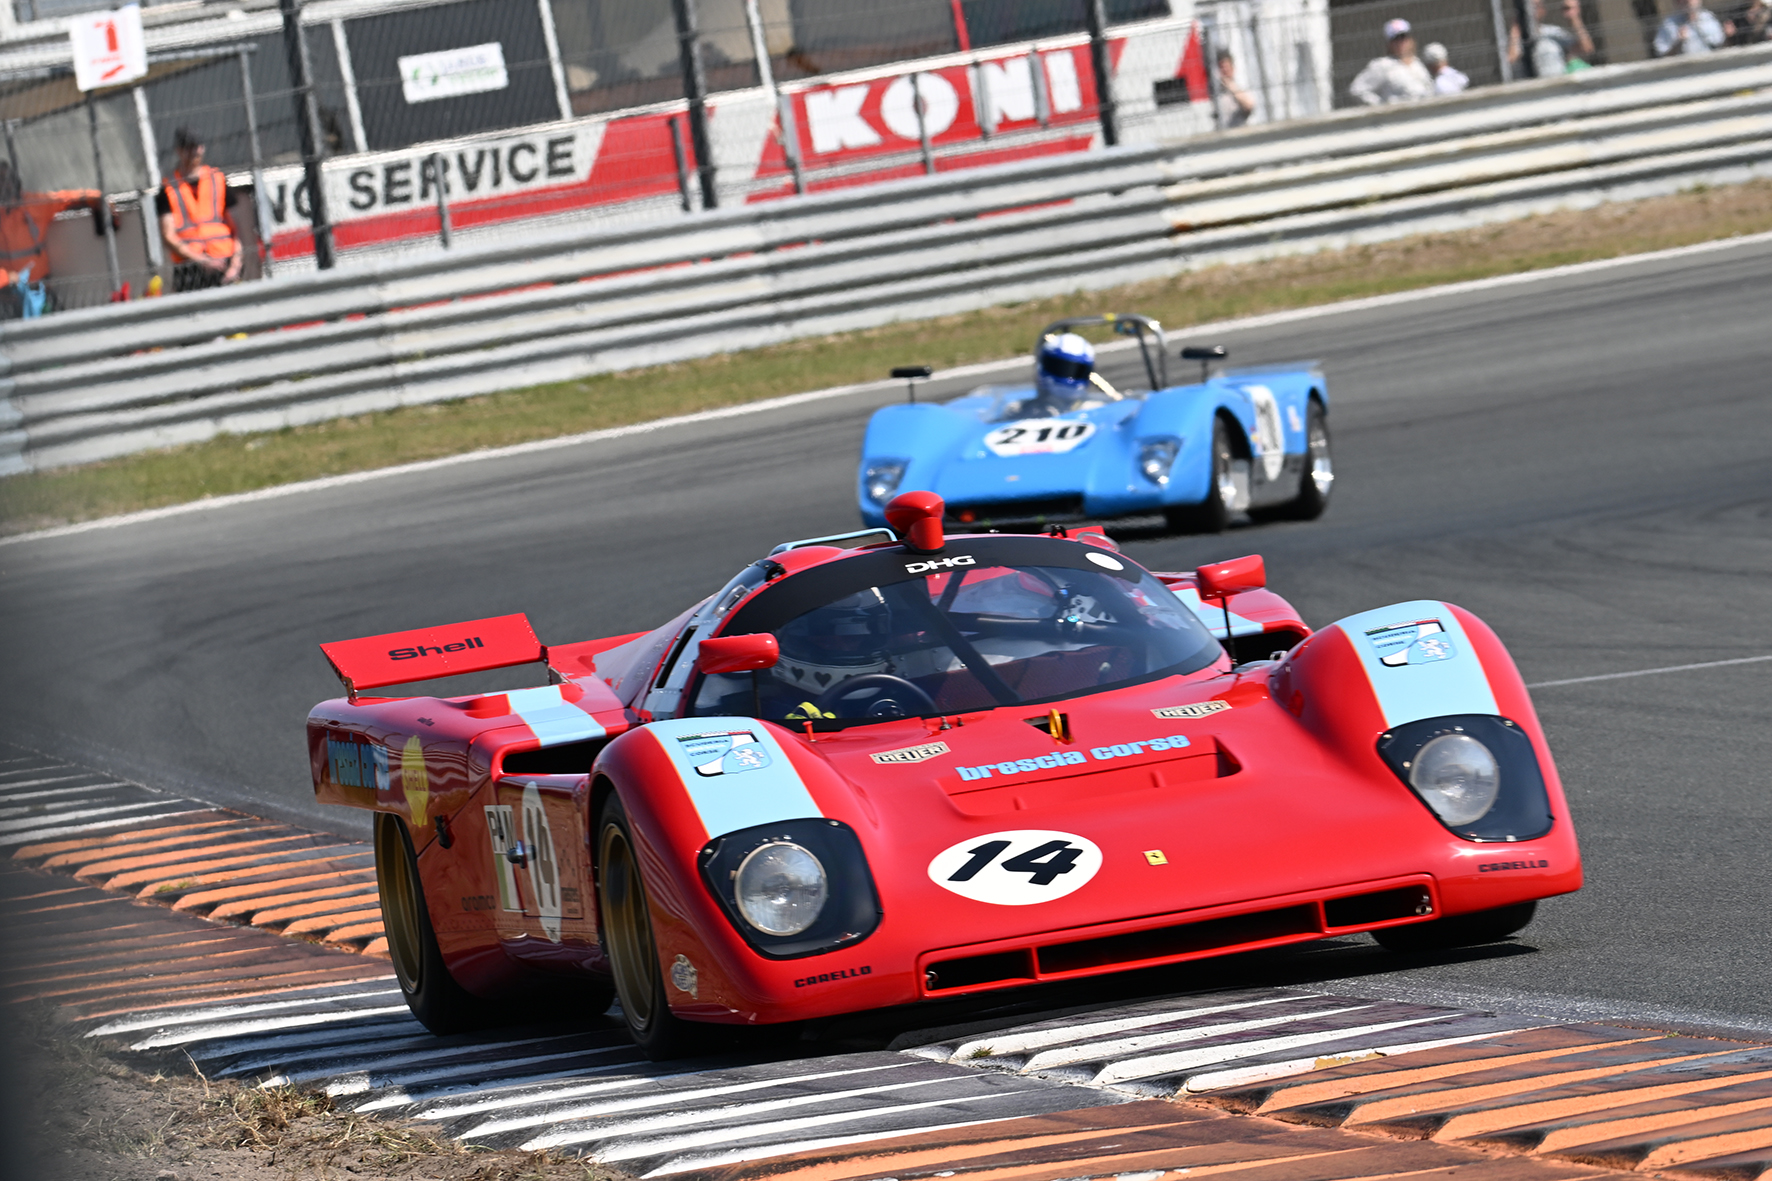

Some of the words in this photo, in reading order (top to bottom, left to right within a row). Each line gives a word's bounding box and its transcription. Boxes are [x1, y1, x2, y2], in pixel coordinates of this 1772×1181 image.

[804, 50, 1083, 154] KONI
[350, 135, 576, 211] SERVICE
[996, 424, 1088, 445] 210
[904, 555, 977, 574] DHG
[388, 636, 485, 661] Shell
[1160, 702, 1225, 717] HEUER
[877, 745, 944, 762] HEUER
[954, 750, 1088, 782] brescia
[1089, 734, 1191, 761] corse
[947, 840, 1084, 886] 14
[1479, 859, 1549, 873] CARELLO
[794, 965, 872, 988] CARELLO
